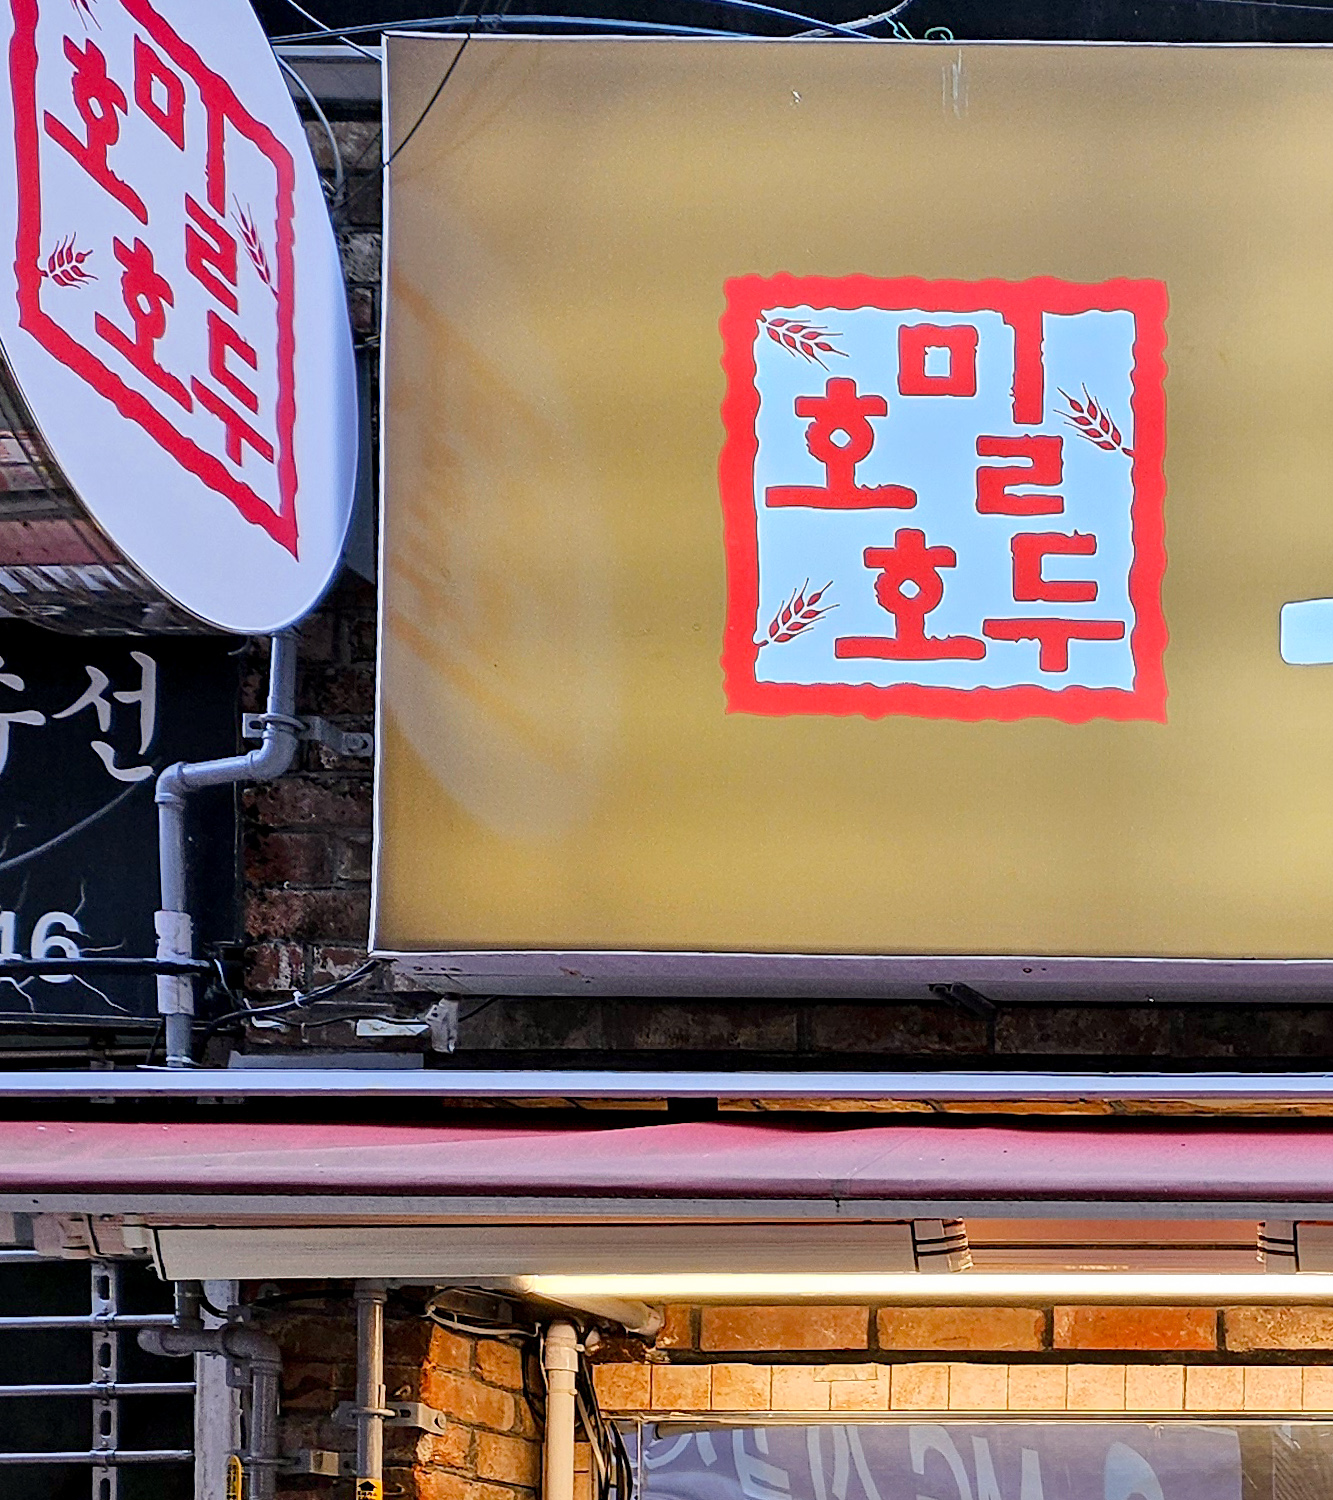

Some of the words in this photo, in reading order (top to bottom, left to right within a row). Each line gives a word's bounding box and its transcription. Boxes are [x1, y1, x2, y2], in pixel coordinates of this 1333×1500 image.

[44, 35, 238, 313] 호밀
[95, 237, 274, 468] 호두
[766, 308, 1064, 515] 호밀
[835, 529, 1125, 672] 호두
